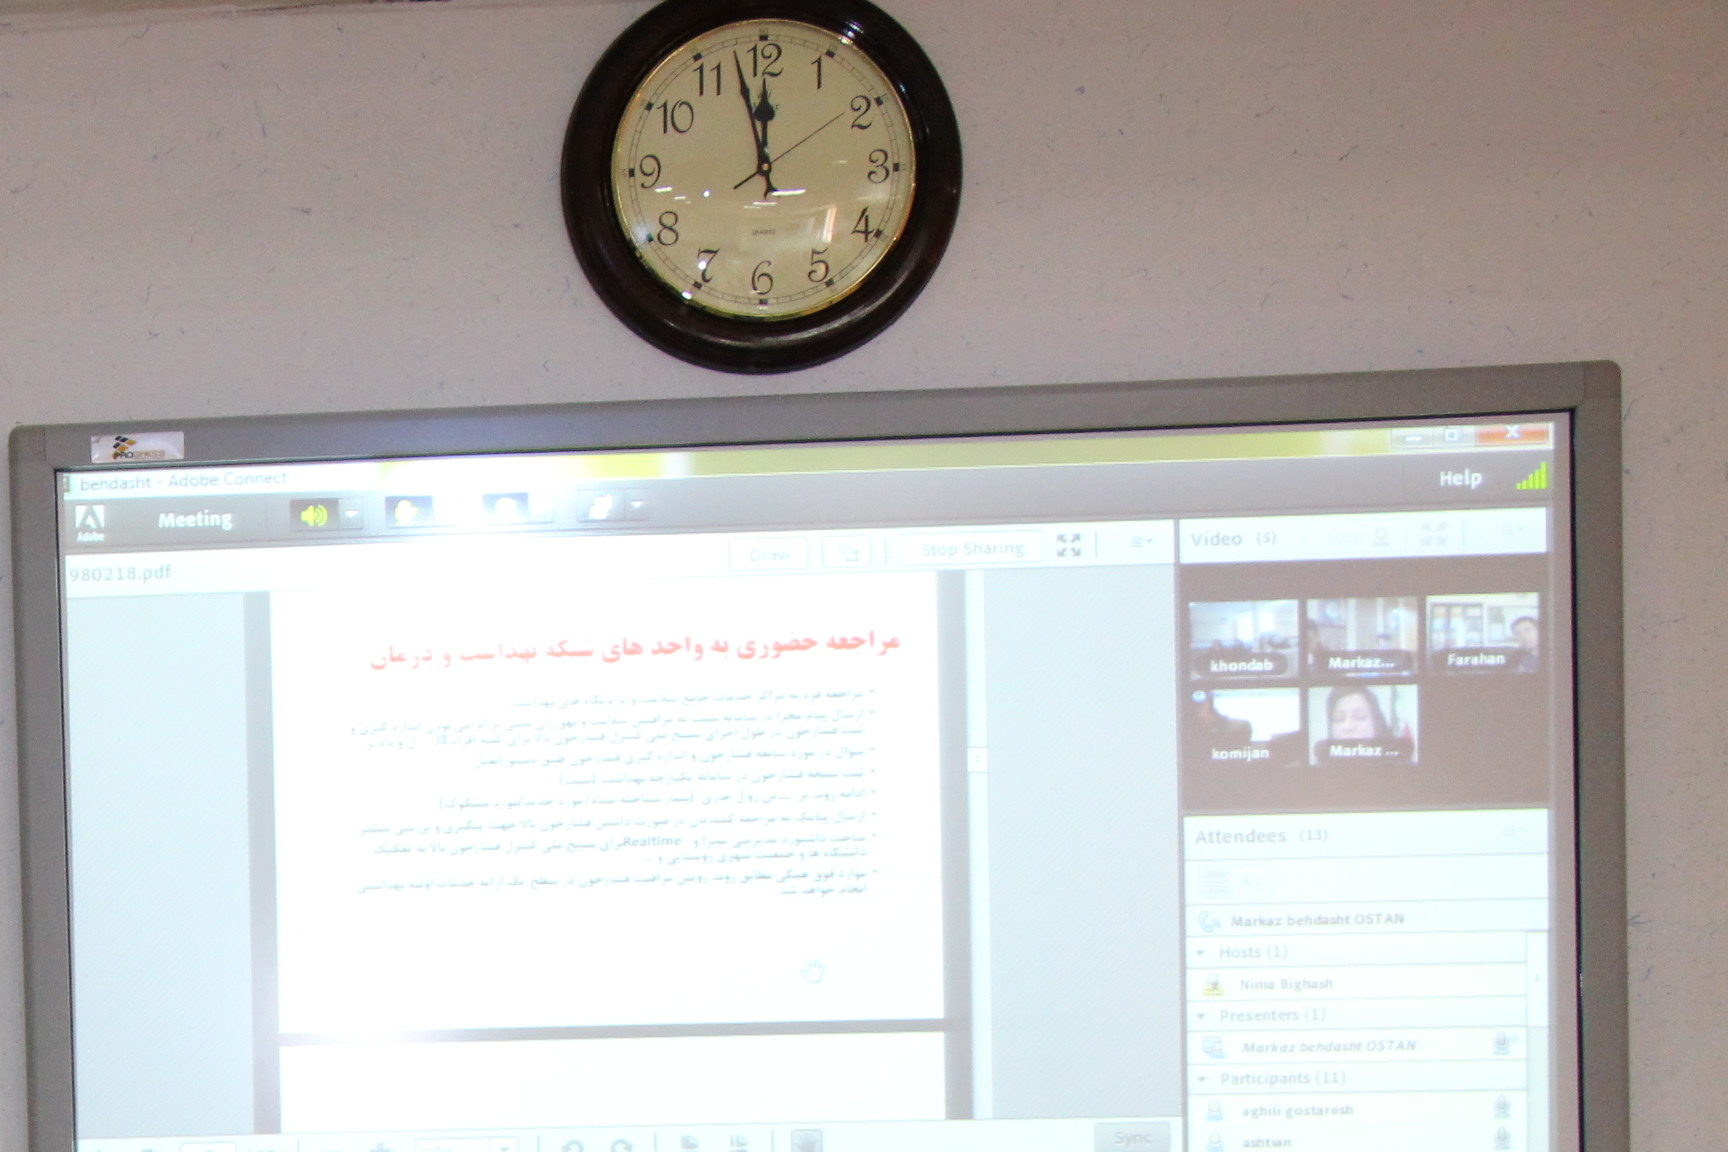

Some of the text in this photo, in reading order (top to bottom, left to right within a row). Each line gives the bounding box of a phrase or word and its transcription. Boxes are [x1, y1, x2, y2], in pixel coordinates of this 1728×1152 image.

[746, 43, 784, 78] 12
[692, 61, 722, 96] 11
[810, 55, 823, 90] 1
[657, 100, 694, 134] 10
[850, 95, 873, 130] 2
[639, 153, 662, 188] 9
[867, 148, 890, 184] 3
[657, 210, 679, 246] 8
[850, 206, 875, 243] 4
[697, 248, 720, 283] 7
[807, 247, 830, 283] 5
[751, 260, 773, 295] 6
[80, 476, 151, 492] behdasht
[167, 473, 219, 488] Adobe
[223, 471, 289, 487] Connect
[1440, 469, 1483, 489] Help
[158, 508, 234, 531] Meeting
[1190, 531, 1243, 547] Video
[69, 564, 172, 584] 980218.pdf
[601, 637, 644, 664] های
[650, 635, 704, 662] واحد
[710, 638, 730, 658] به
[736, 632, 819, 660] حضوری
[826, 629, 901, 656] مراجعه
[1210, 658, 1274, 672] khondab
[1447, 652, 1506, 666] Farahan
[1211, 746, 1270, 761] komijan
[1330, 745, 1382, 757] Markaz
[1195, 829, 1287, 845] Attendees
[1230, 913, 1405, 928] Markaz behdasht OSTAN
[1219, 946, 1262, 960] Hosts
[1220, 1009, 1300, 1023] Presenters
[1240, 1038, 1418, 1054] Markaz behdasht OSTAN
[1220, 1071, 1311, 1087] Participants
[1284, 1103, 1355, 1120] gostaresh
[1114, 1129, 1153, 1148] Sync
